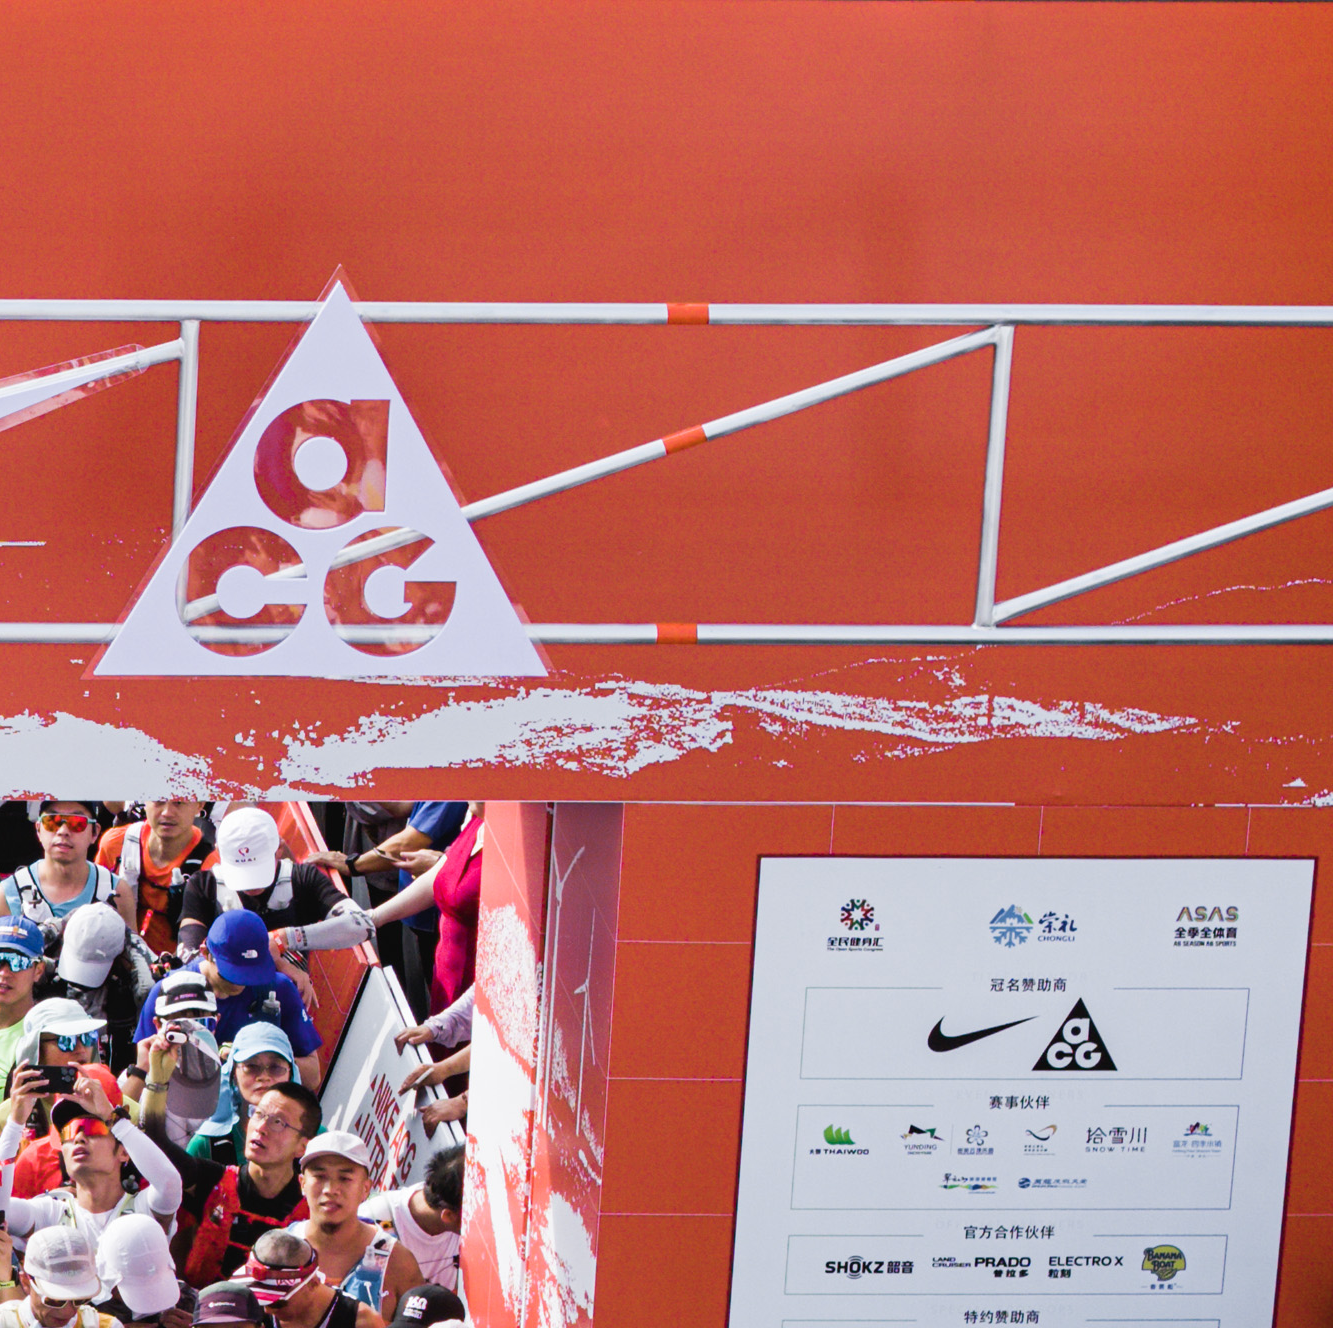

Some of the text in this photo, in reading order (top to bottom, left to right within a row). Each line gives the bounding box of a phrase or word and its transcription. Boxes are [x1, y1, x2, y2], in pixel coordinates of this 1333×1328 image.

[1175, 927, 1237, 940] 全季全体育
[828, 937, 883, 947] 全民健身汇
[991, 978, 1066, 992] 冠名赞助商
[375, 1073, 399, 1141] NIKE
[990, 1095, 1049, 1109] 赛事伙伴
[1086, 1127, 1147, 1144] 拾雪川
[964, 1225, 1054, 1239] 官方合作伙伴
[825, 1260, 884, 1274] SHOKZ
[975, 1257, 1031, 1267] PRADO
[1049, 1256, 1123, 1266] ELECTRO X
[964, 1310, 1039, 1324] 特约赞助商
